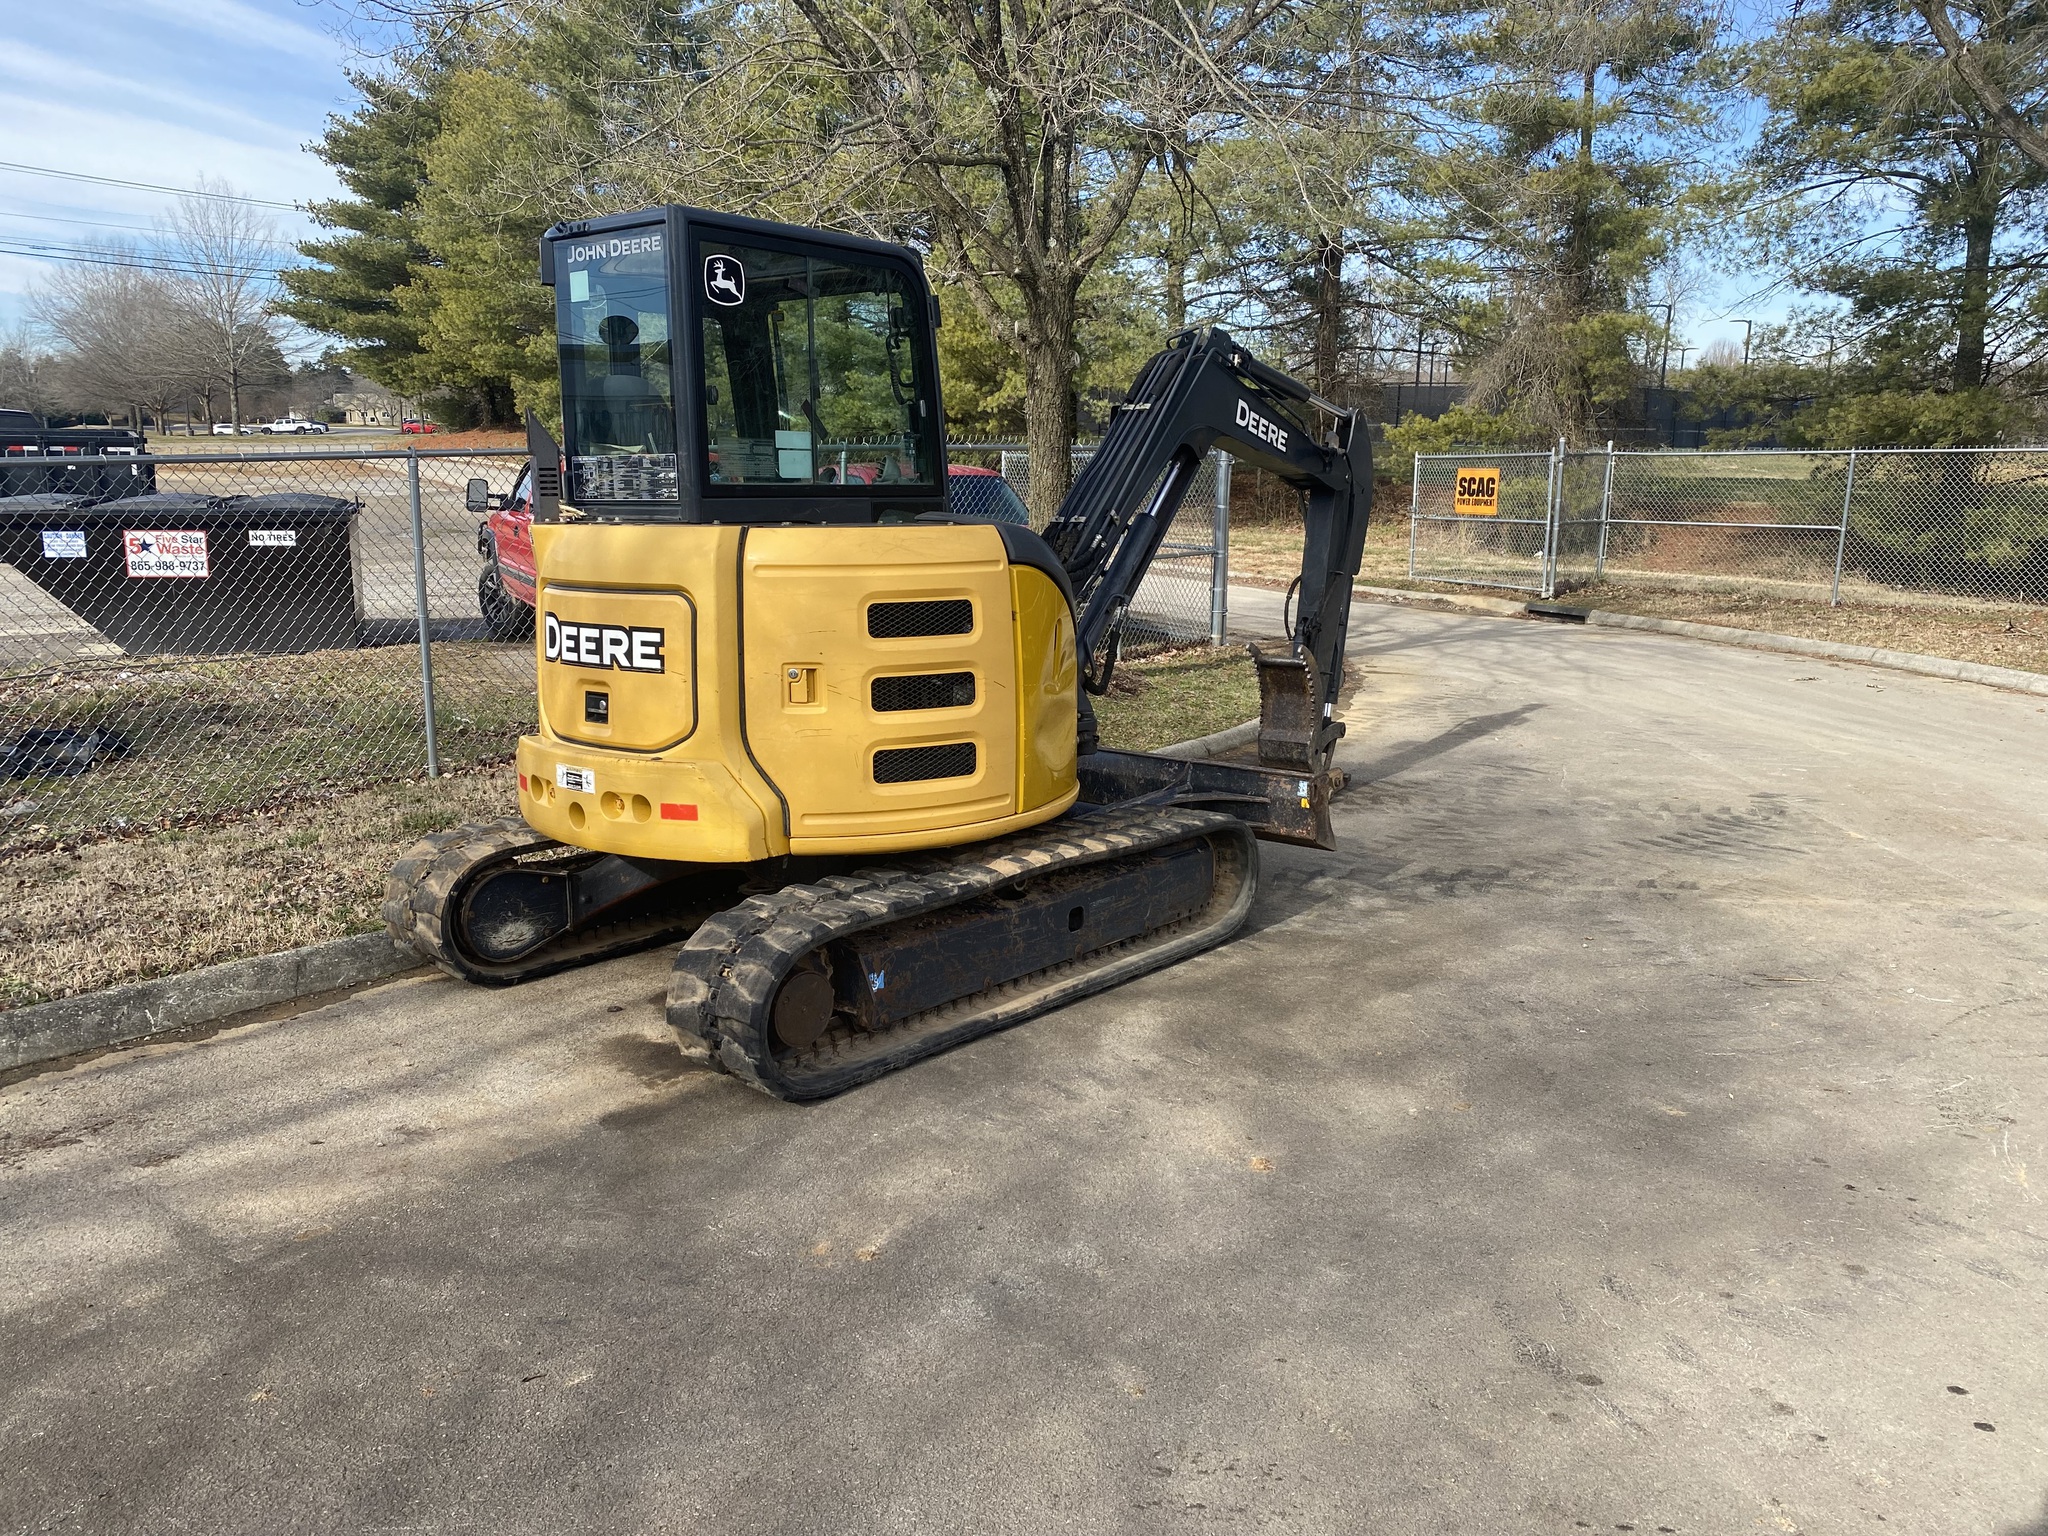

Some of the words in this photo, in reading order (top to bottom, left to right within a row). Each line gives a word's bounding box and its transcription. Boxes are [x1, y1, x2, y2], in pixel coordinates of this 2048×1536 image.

[567, 243, 607, 263] JOHN
[610, 235, 662, 256] DEERE
[1235, 398, 1288, 453] DEERE
[1458, 476, 1496, 498] SCAG
[1457, 498, 1470, 506] POWER
[155, 534, 178, 544] Five
[181, 534, 204, 544] Star
[251, 533, 265, 541] NO
[267, 533, 294, 542] TIRES
[156, 543, 204, 555] Waste
[130, 560, 205, 571] 865-988-9737
[545, 614, 663, 671] DEERE
